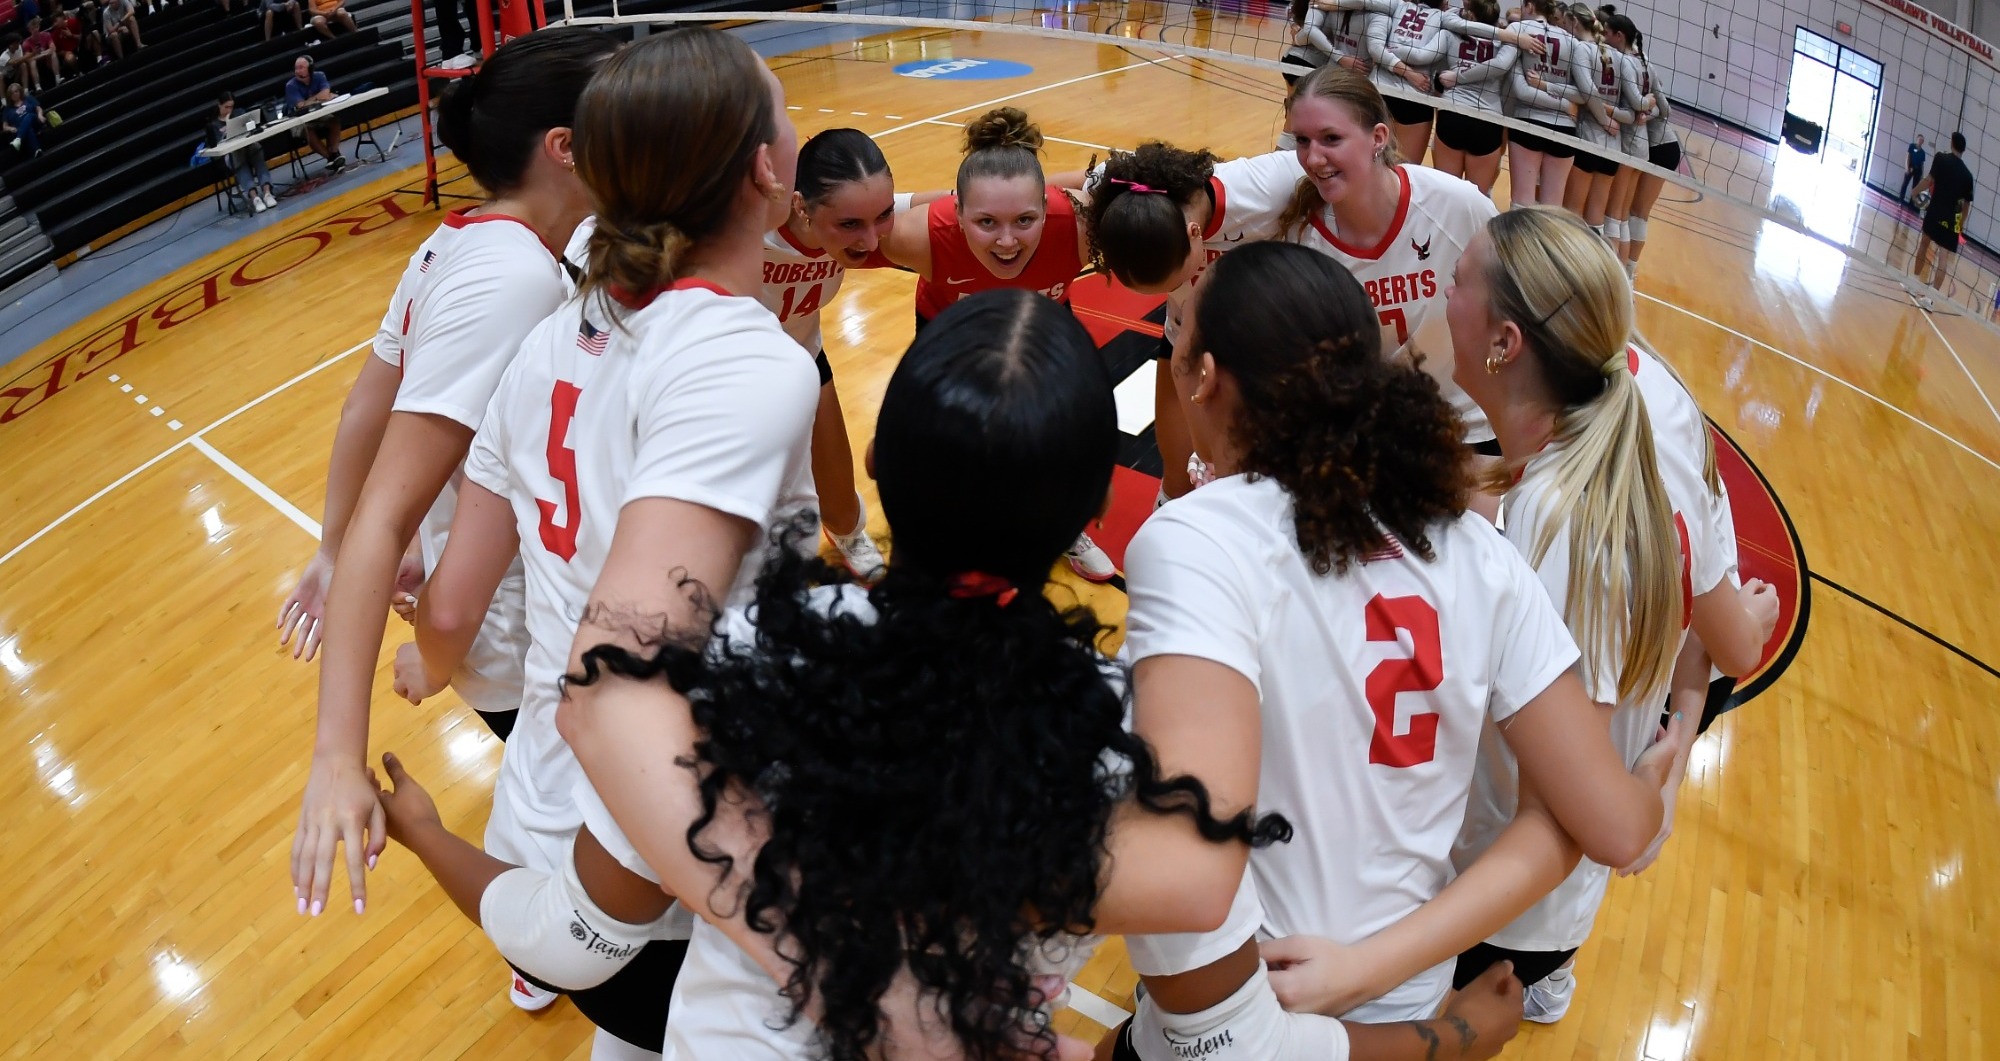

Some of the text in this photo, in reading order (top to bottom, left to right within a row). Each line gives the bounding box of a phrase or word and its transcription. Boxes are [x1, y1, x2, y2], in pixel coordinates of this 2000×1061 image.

[1398, 8, 1429, 32] 25
[1930, 15, 1994, 61] VOLLEYBALL
[1458, 36, 1494, 64] 20
[763, 260, 844, 284] ROBERT
[1364, 268, 1437, 308] BERTS
[779, 282, 823, 323] 14
[1377, 307, 1409, 347] 7
[535, 378, 583, 564] 5
[1364, 591, 1445, 769] 2
[573, 908, 646, 960] Tand
